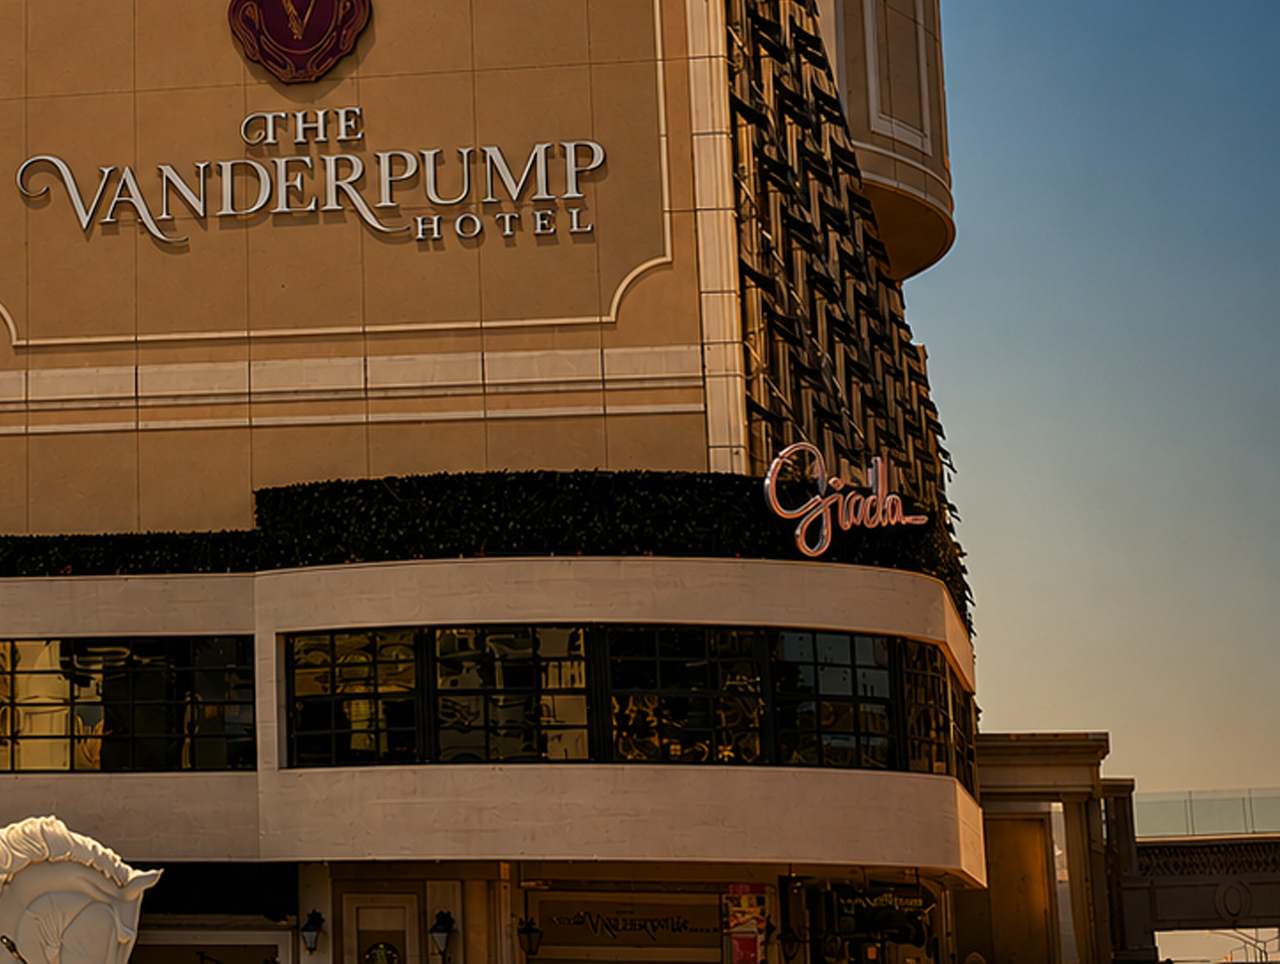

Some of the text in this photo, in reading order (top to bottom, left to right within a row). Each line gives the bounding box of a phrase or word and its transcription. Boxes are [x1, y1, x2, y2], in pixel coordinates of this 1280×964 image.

[241, 107, 363, 146] THE
[16, 141, 607, 244] VANDERPUMP
[415, 208, 594, 241] HOTEL
[764, 441, 928, 557] Giada
